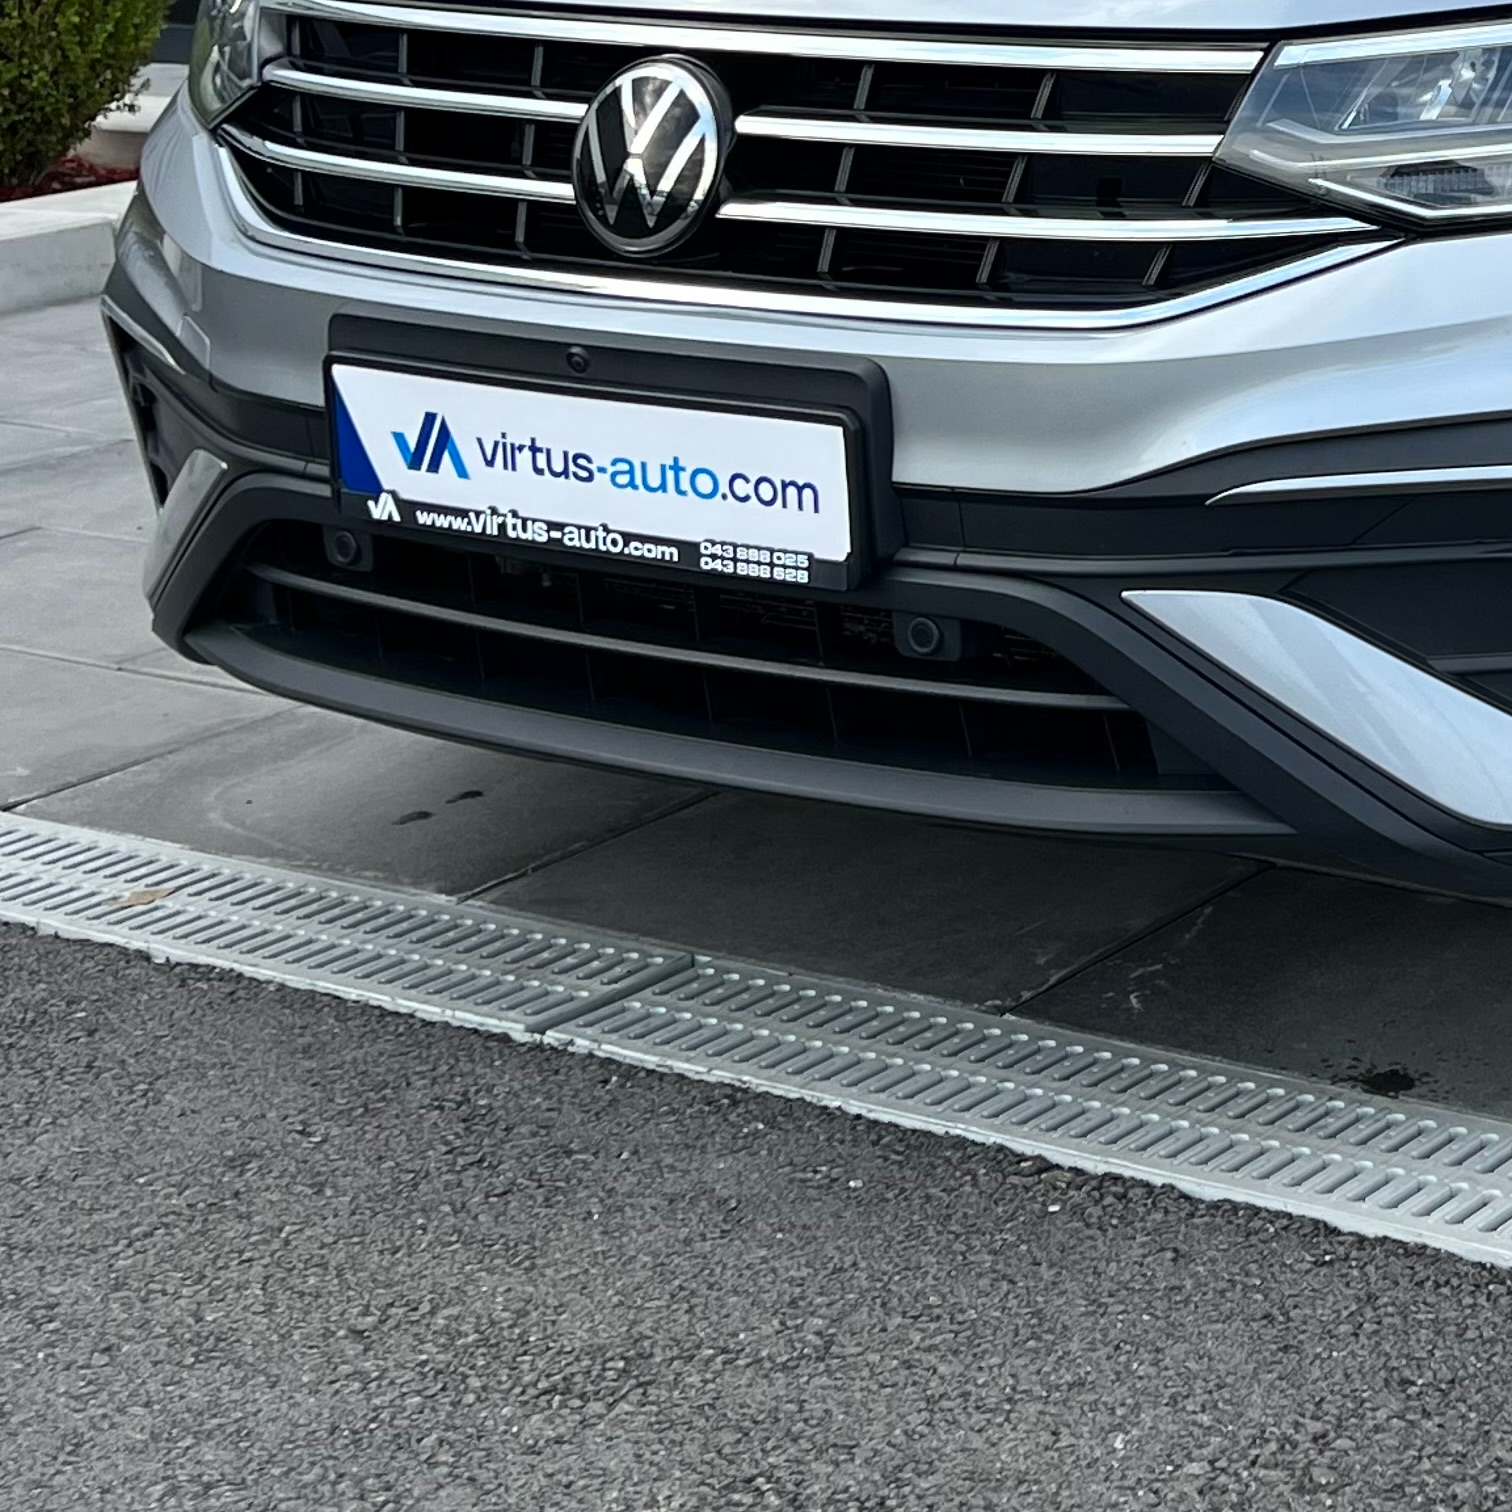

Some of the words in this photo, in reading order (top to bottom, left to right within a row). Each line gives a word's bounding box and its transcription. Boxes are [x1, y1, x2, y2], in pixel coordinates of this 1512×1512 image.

[476, 432, 820, 514] virtus-auto.com
[416, 509, 679, 563] www.virtus-auto.com
[699, 541, 735, 559] 043
[699, 556, 735, 573] 043
